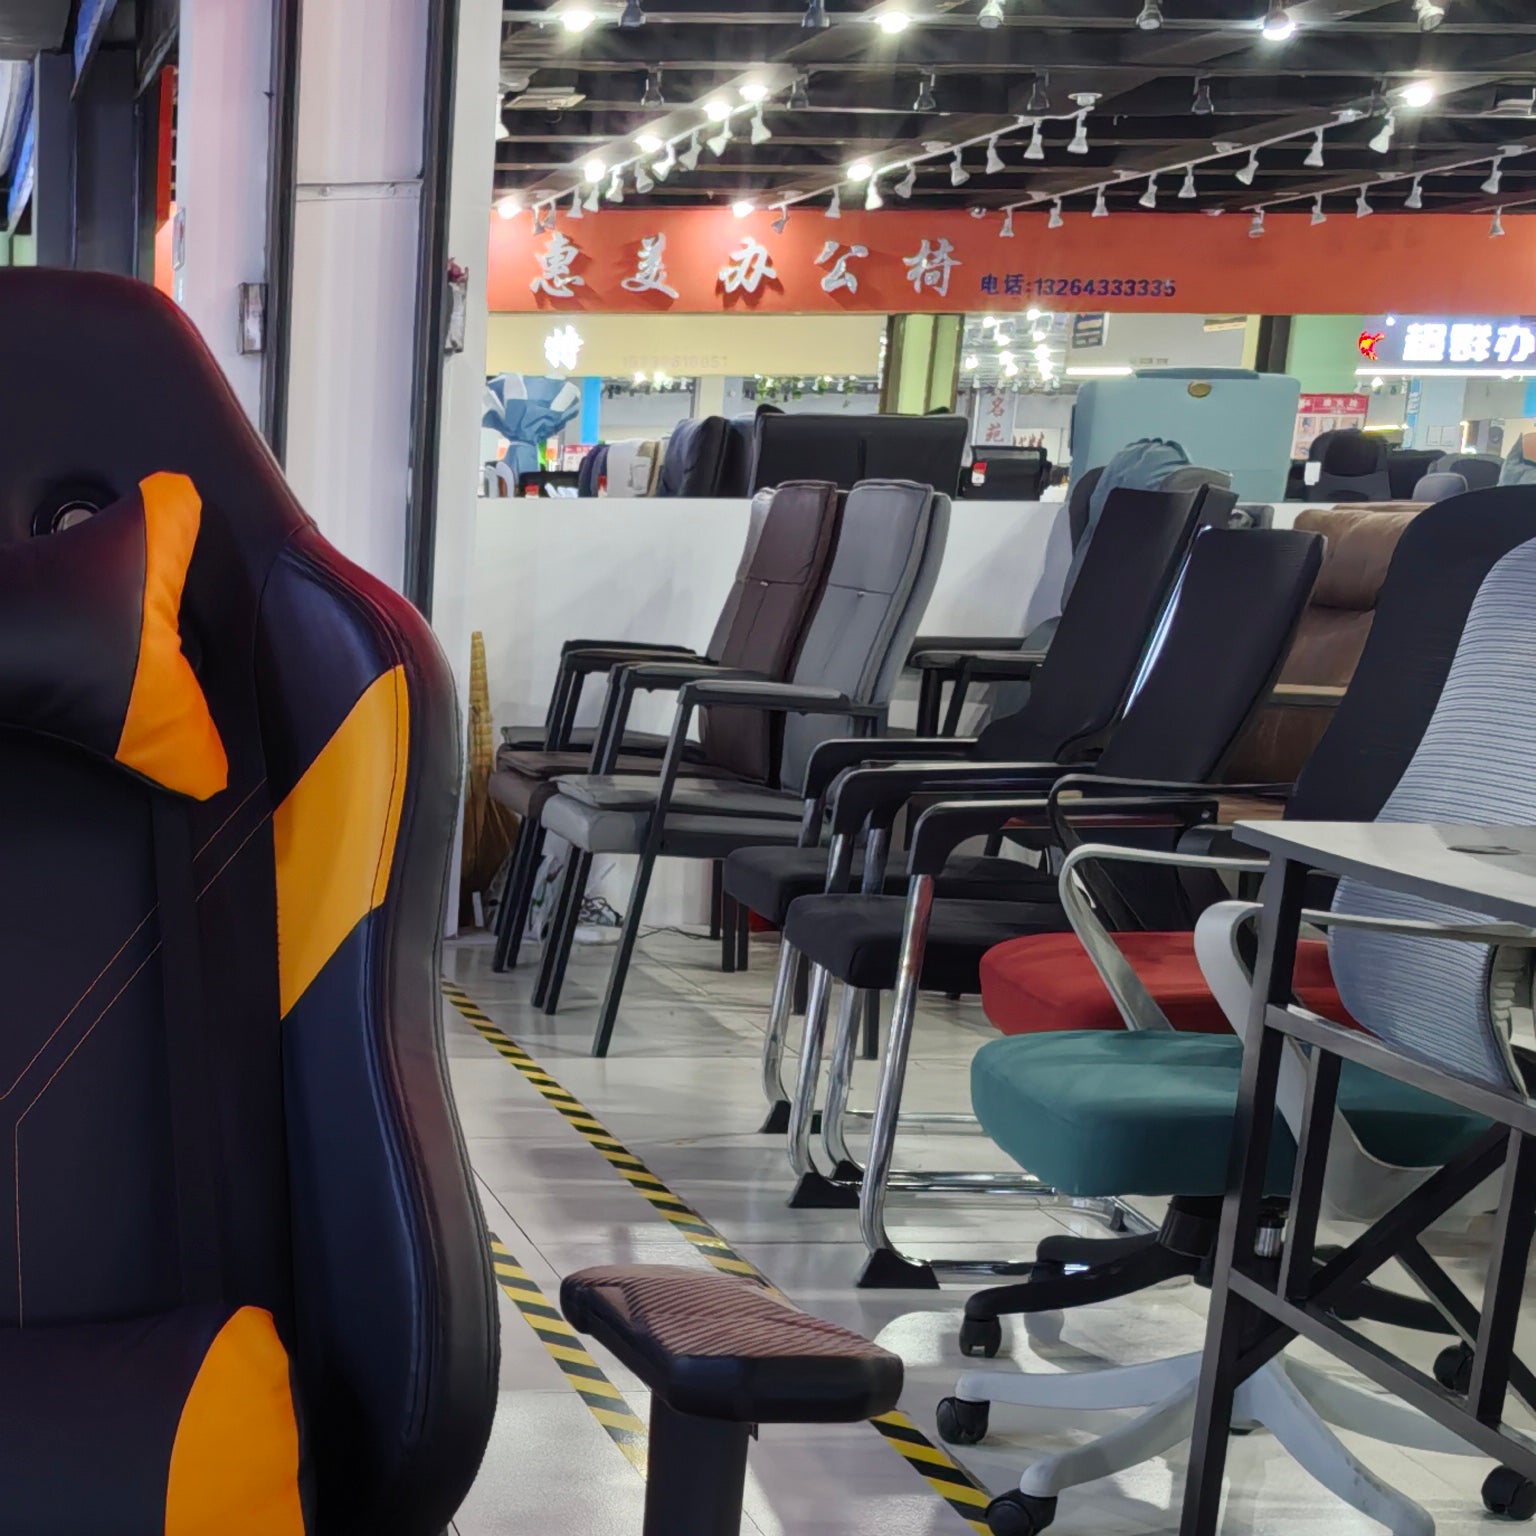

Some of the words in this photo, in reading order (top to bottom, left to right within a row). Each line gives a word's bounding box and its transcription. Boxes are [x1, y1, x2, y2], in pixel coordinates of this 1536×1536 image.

[529, 230, 962, 299] 惠美办公椅
